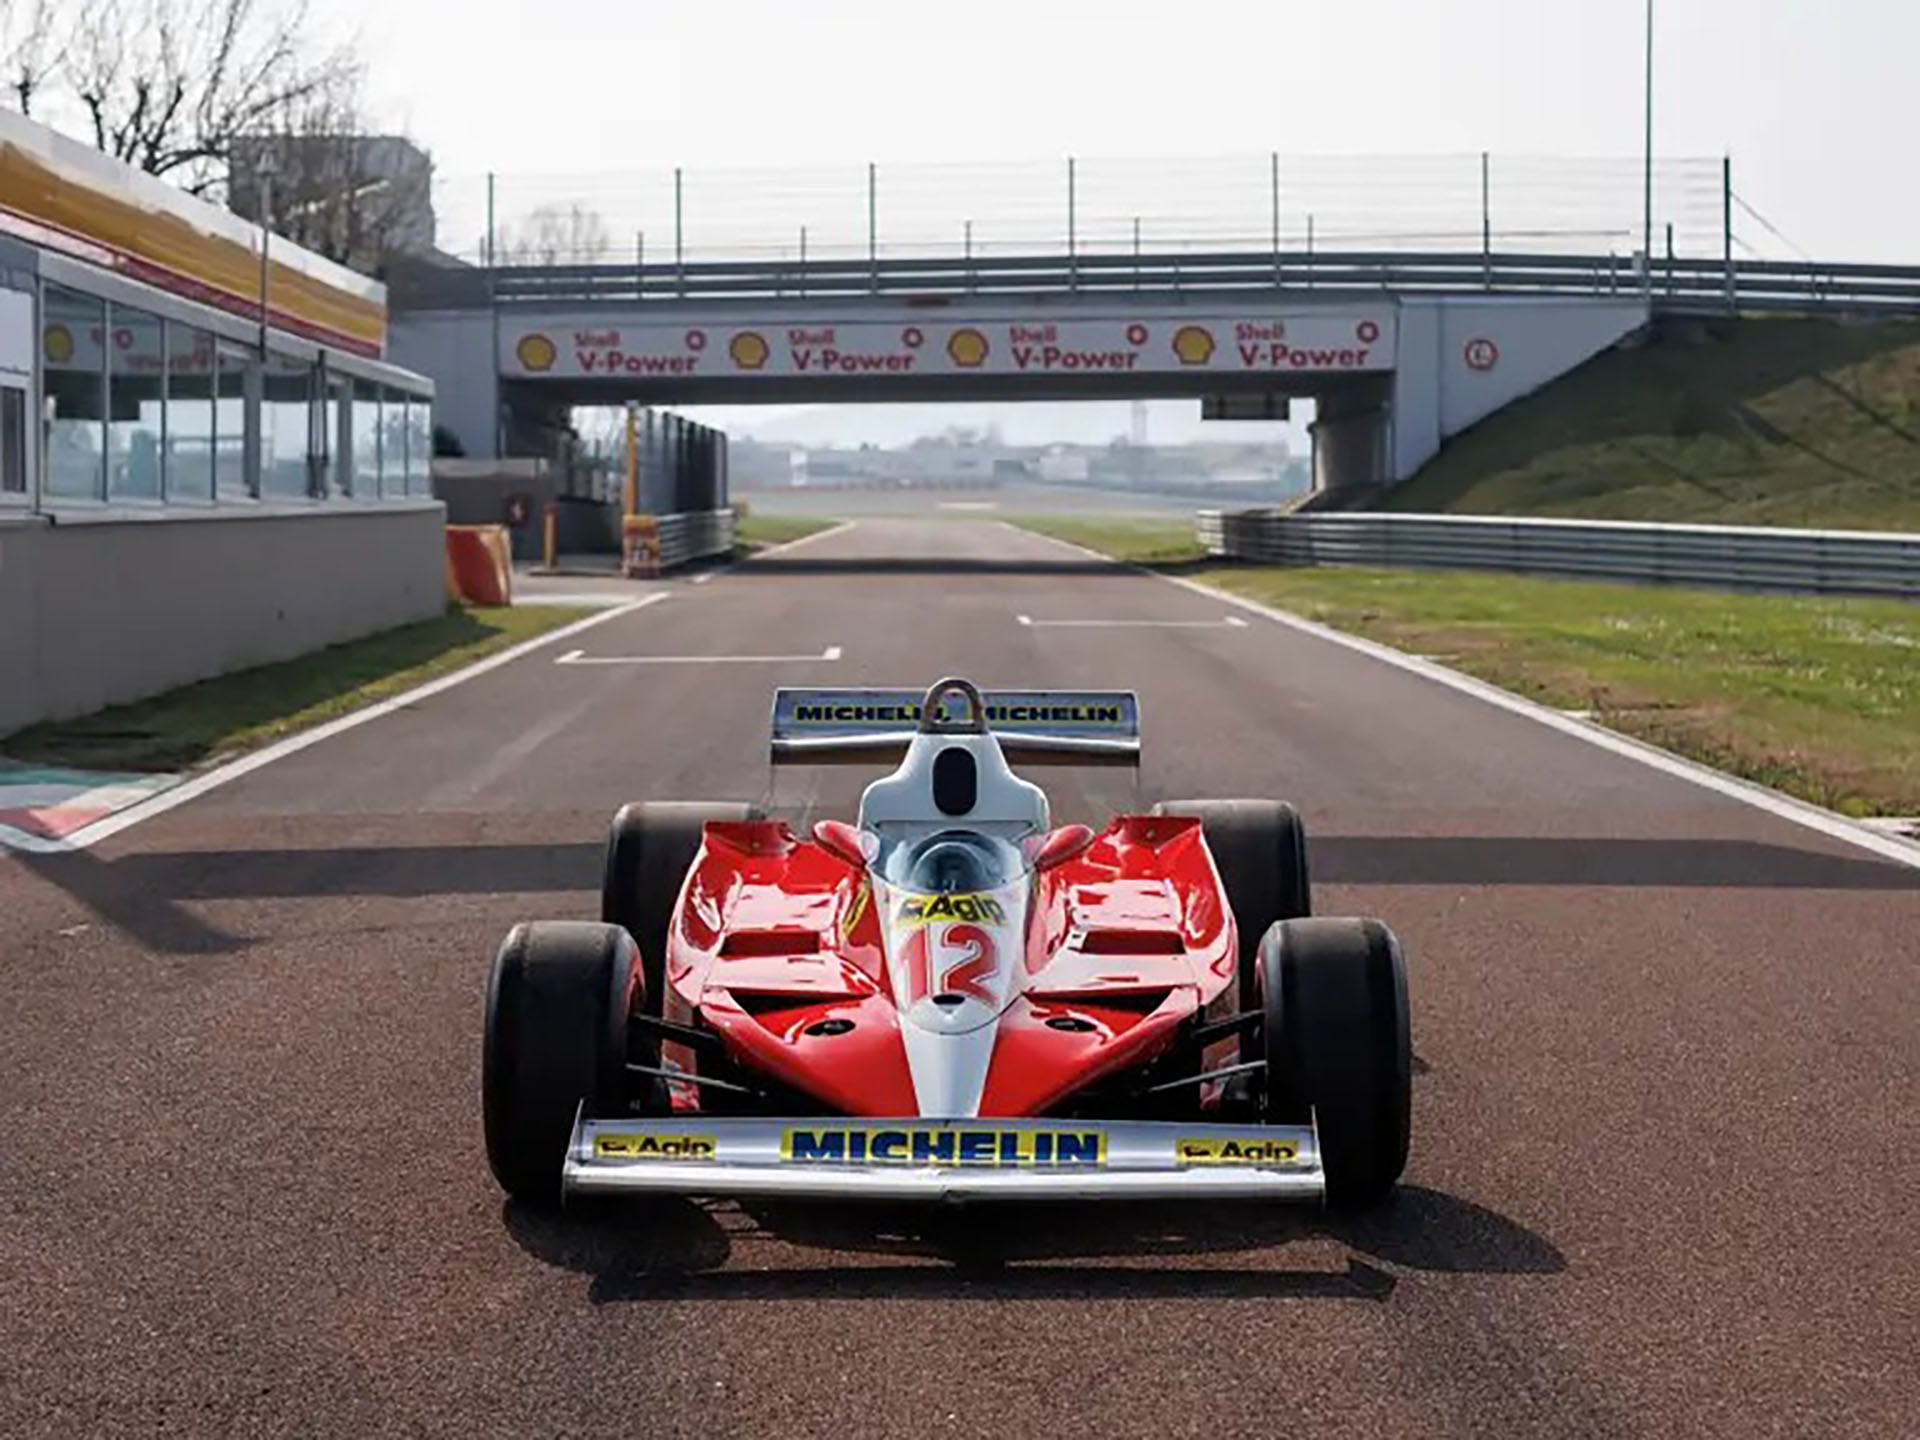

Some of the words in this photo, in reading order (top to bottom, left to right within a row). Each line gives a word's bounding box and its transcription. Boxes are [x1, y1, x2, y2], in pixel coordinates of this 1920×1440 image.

[789, 328, 834, 346] Shell
[1010, 325, 1055, 342] Shell
[1236, 322, 1284, 340] Shell
[577, 350, 699, 373] V-Power
[791, 348, 914, 371] V-Power
[1012, 345, 1138, 369] V-Power
[1239, 342, 1368, 367] V-Power
[926, 895, 1006, 924] Agip
[898, 924, 1001, 1007] 12
[636, 1138, 713, 1156] Agip
[792, 1131, 1099, 1162] MICHELIN
[1220, 1141, 1297, 1160] Agip
